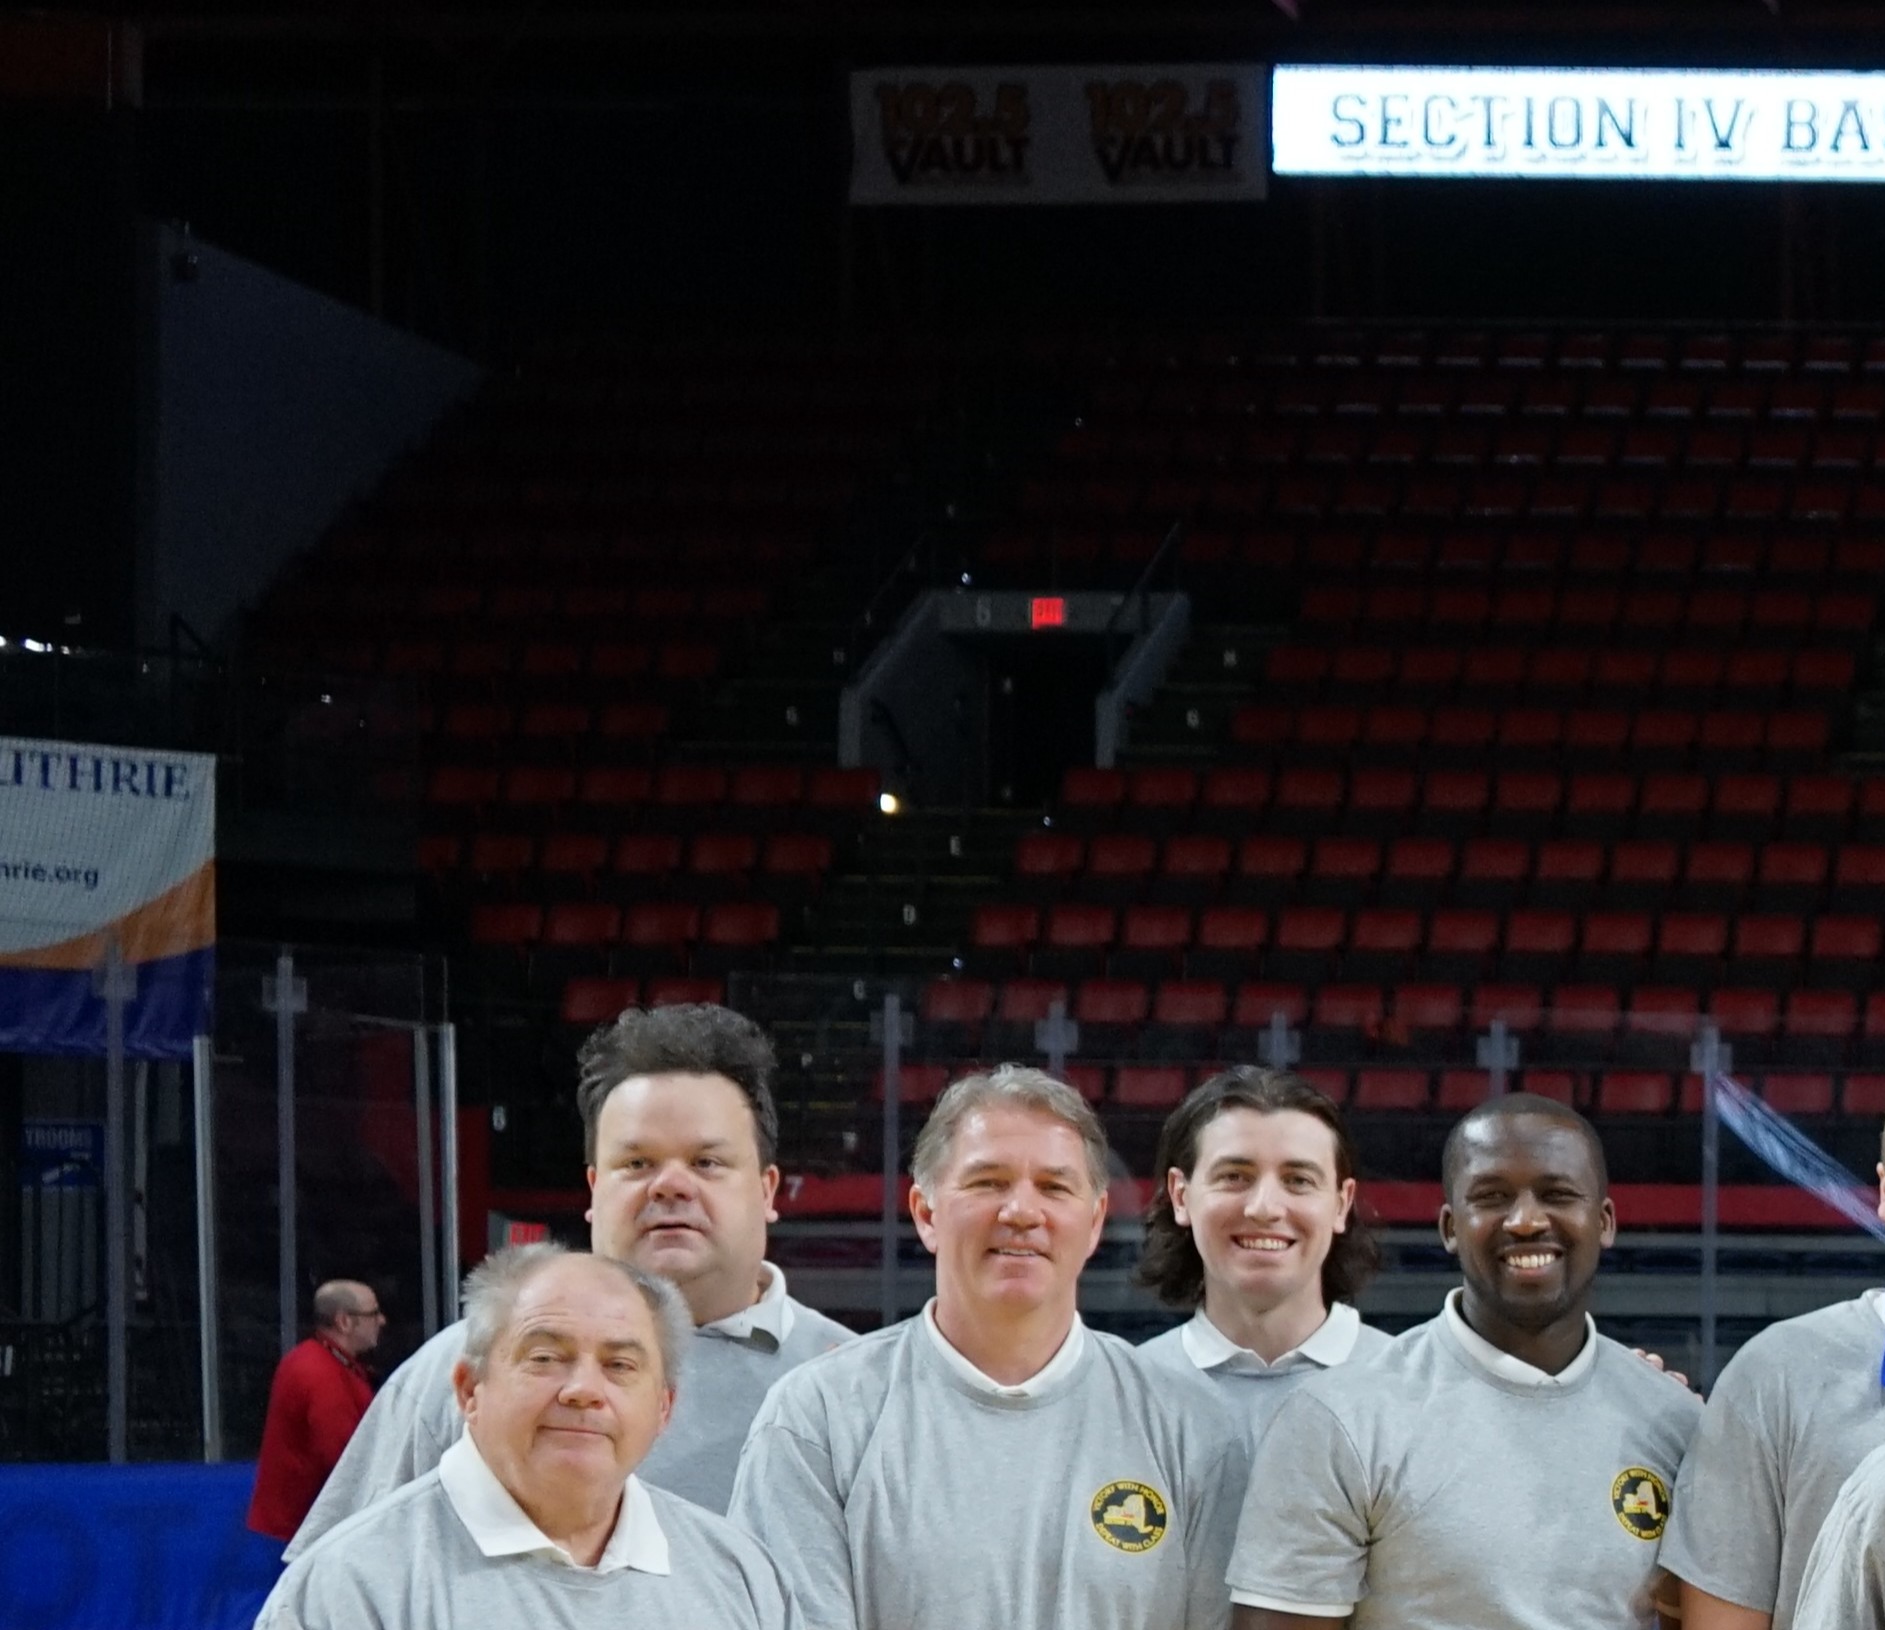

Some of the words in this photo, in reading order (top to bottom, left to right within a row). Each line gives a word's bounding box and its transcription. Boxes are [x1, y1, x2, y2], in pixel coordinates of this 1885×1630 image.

[1330, 95, 1638, 149] SECTION
[1675, 96, 1745, 150] IV
[884, 132, 1030, 184] VAULT
[1096, 132, 1240, 184] VAULT
